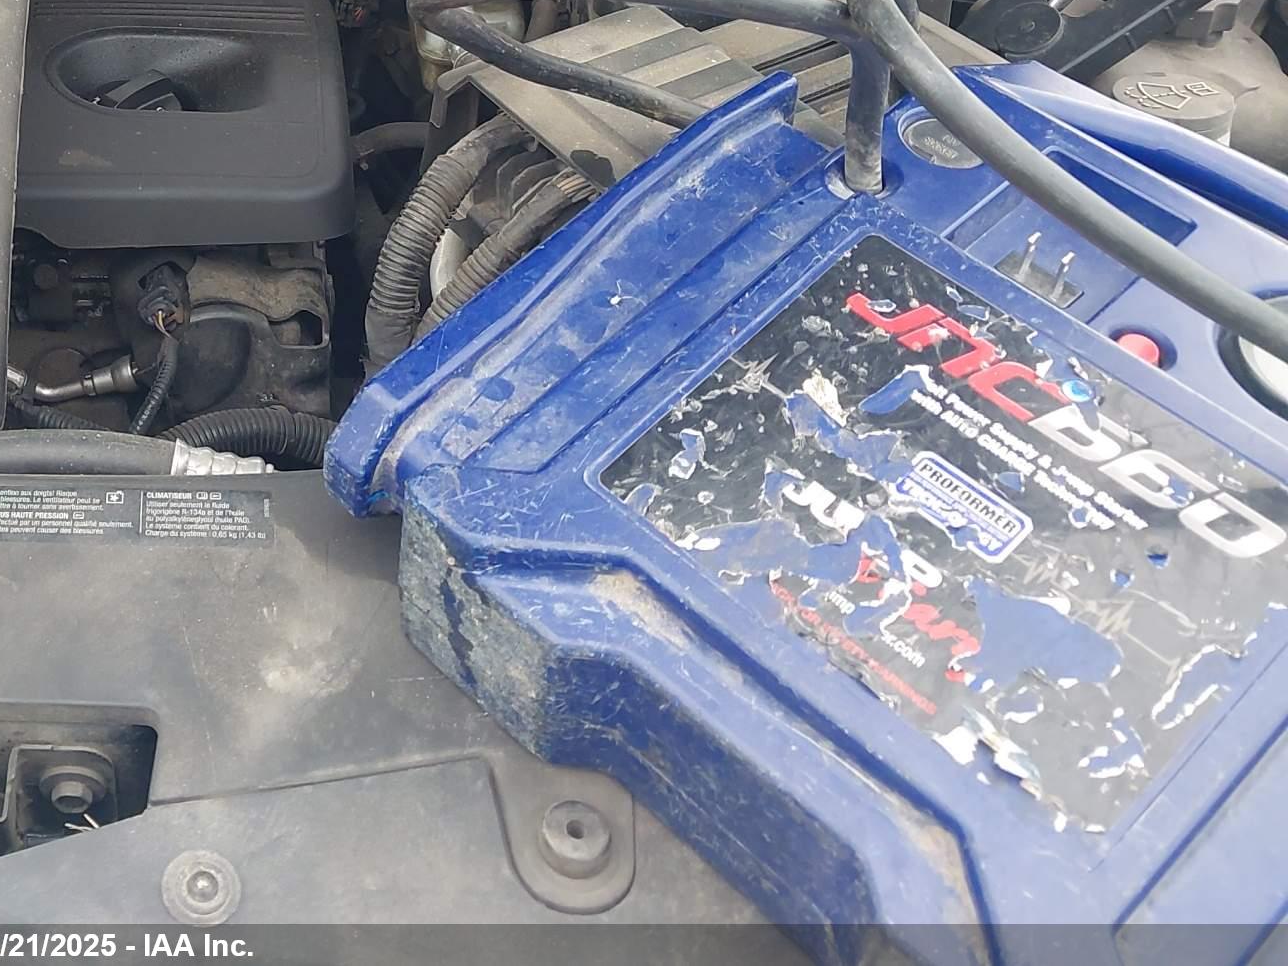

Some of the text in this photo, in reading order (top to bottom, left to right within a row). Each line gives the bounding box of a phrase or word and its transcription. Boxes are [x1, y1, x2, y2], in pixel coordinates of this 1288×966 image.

[940, 410, 979, 439] AUTO
[977, 434, 1037, 476] CHARGE
[919, 462, 1017, 533] PROFORMER
